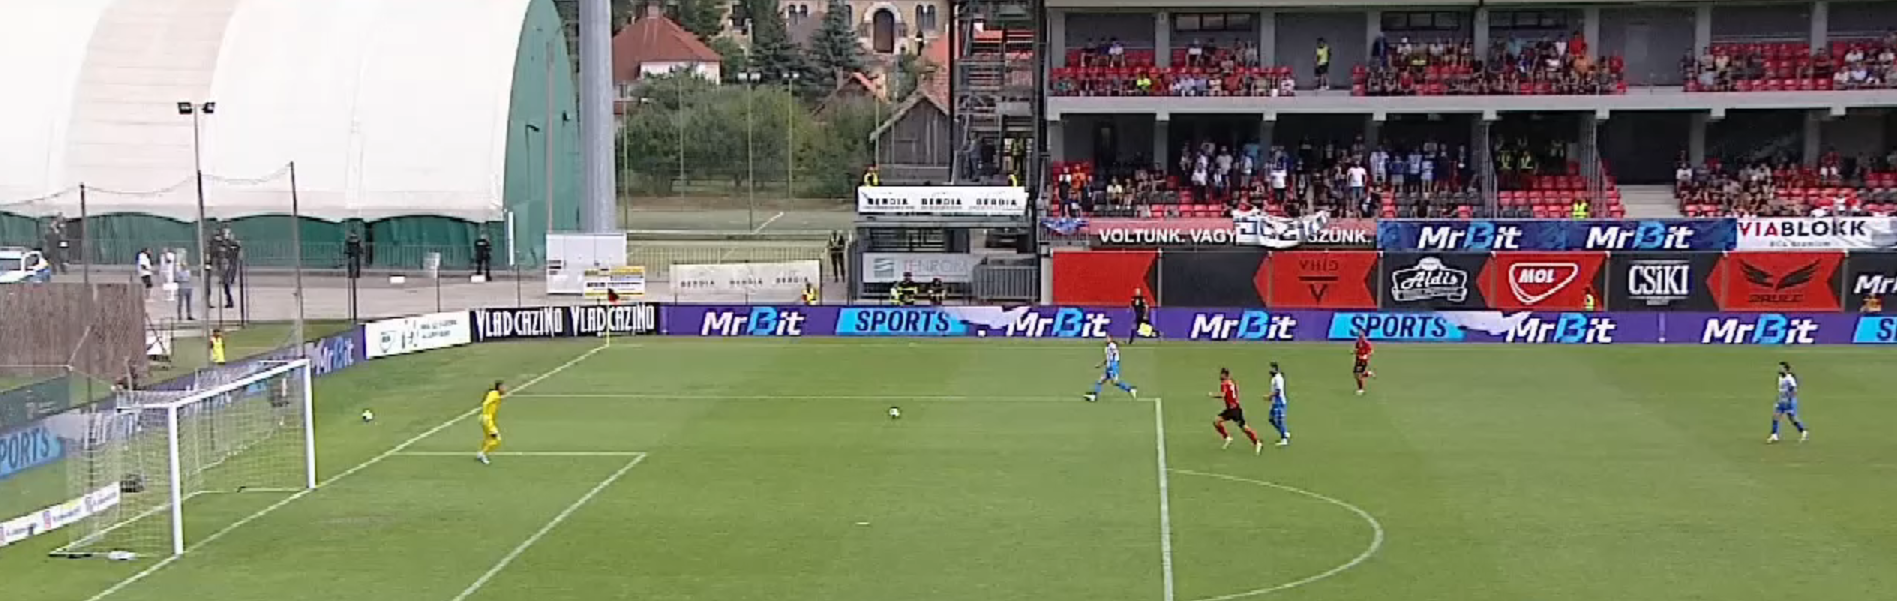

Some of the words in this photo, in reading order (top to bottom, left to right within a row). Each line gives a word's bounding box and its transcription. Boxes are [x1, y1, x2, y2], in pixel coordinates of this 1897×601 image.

[1418, 221, 1523, 249] MrBit
[1586, 221, 1694, 249] MrBit
[1737, 220, 1866, 237] VIABLOKK
[1518, 269, 1554, 283] MOL
[1854, 275, 1897, 294] Mr
[701, 307, 806, 336] MrBit
[855, 310, 950, 332] SPORTS
[1006, 307, 1111, 337] MrBit
[1191, 309, 1297, 339] MrBit
[1350, 316, 1447, 337] SPORTS
[1506, 312, 1616, 343] MrBit
[1702, 313, 1819, 343] MrBit
[0, 426, 49, 470] PORTS
